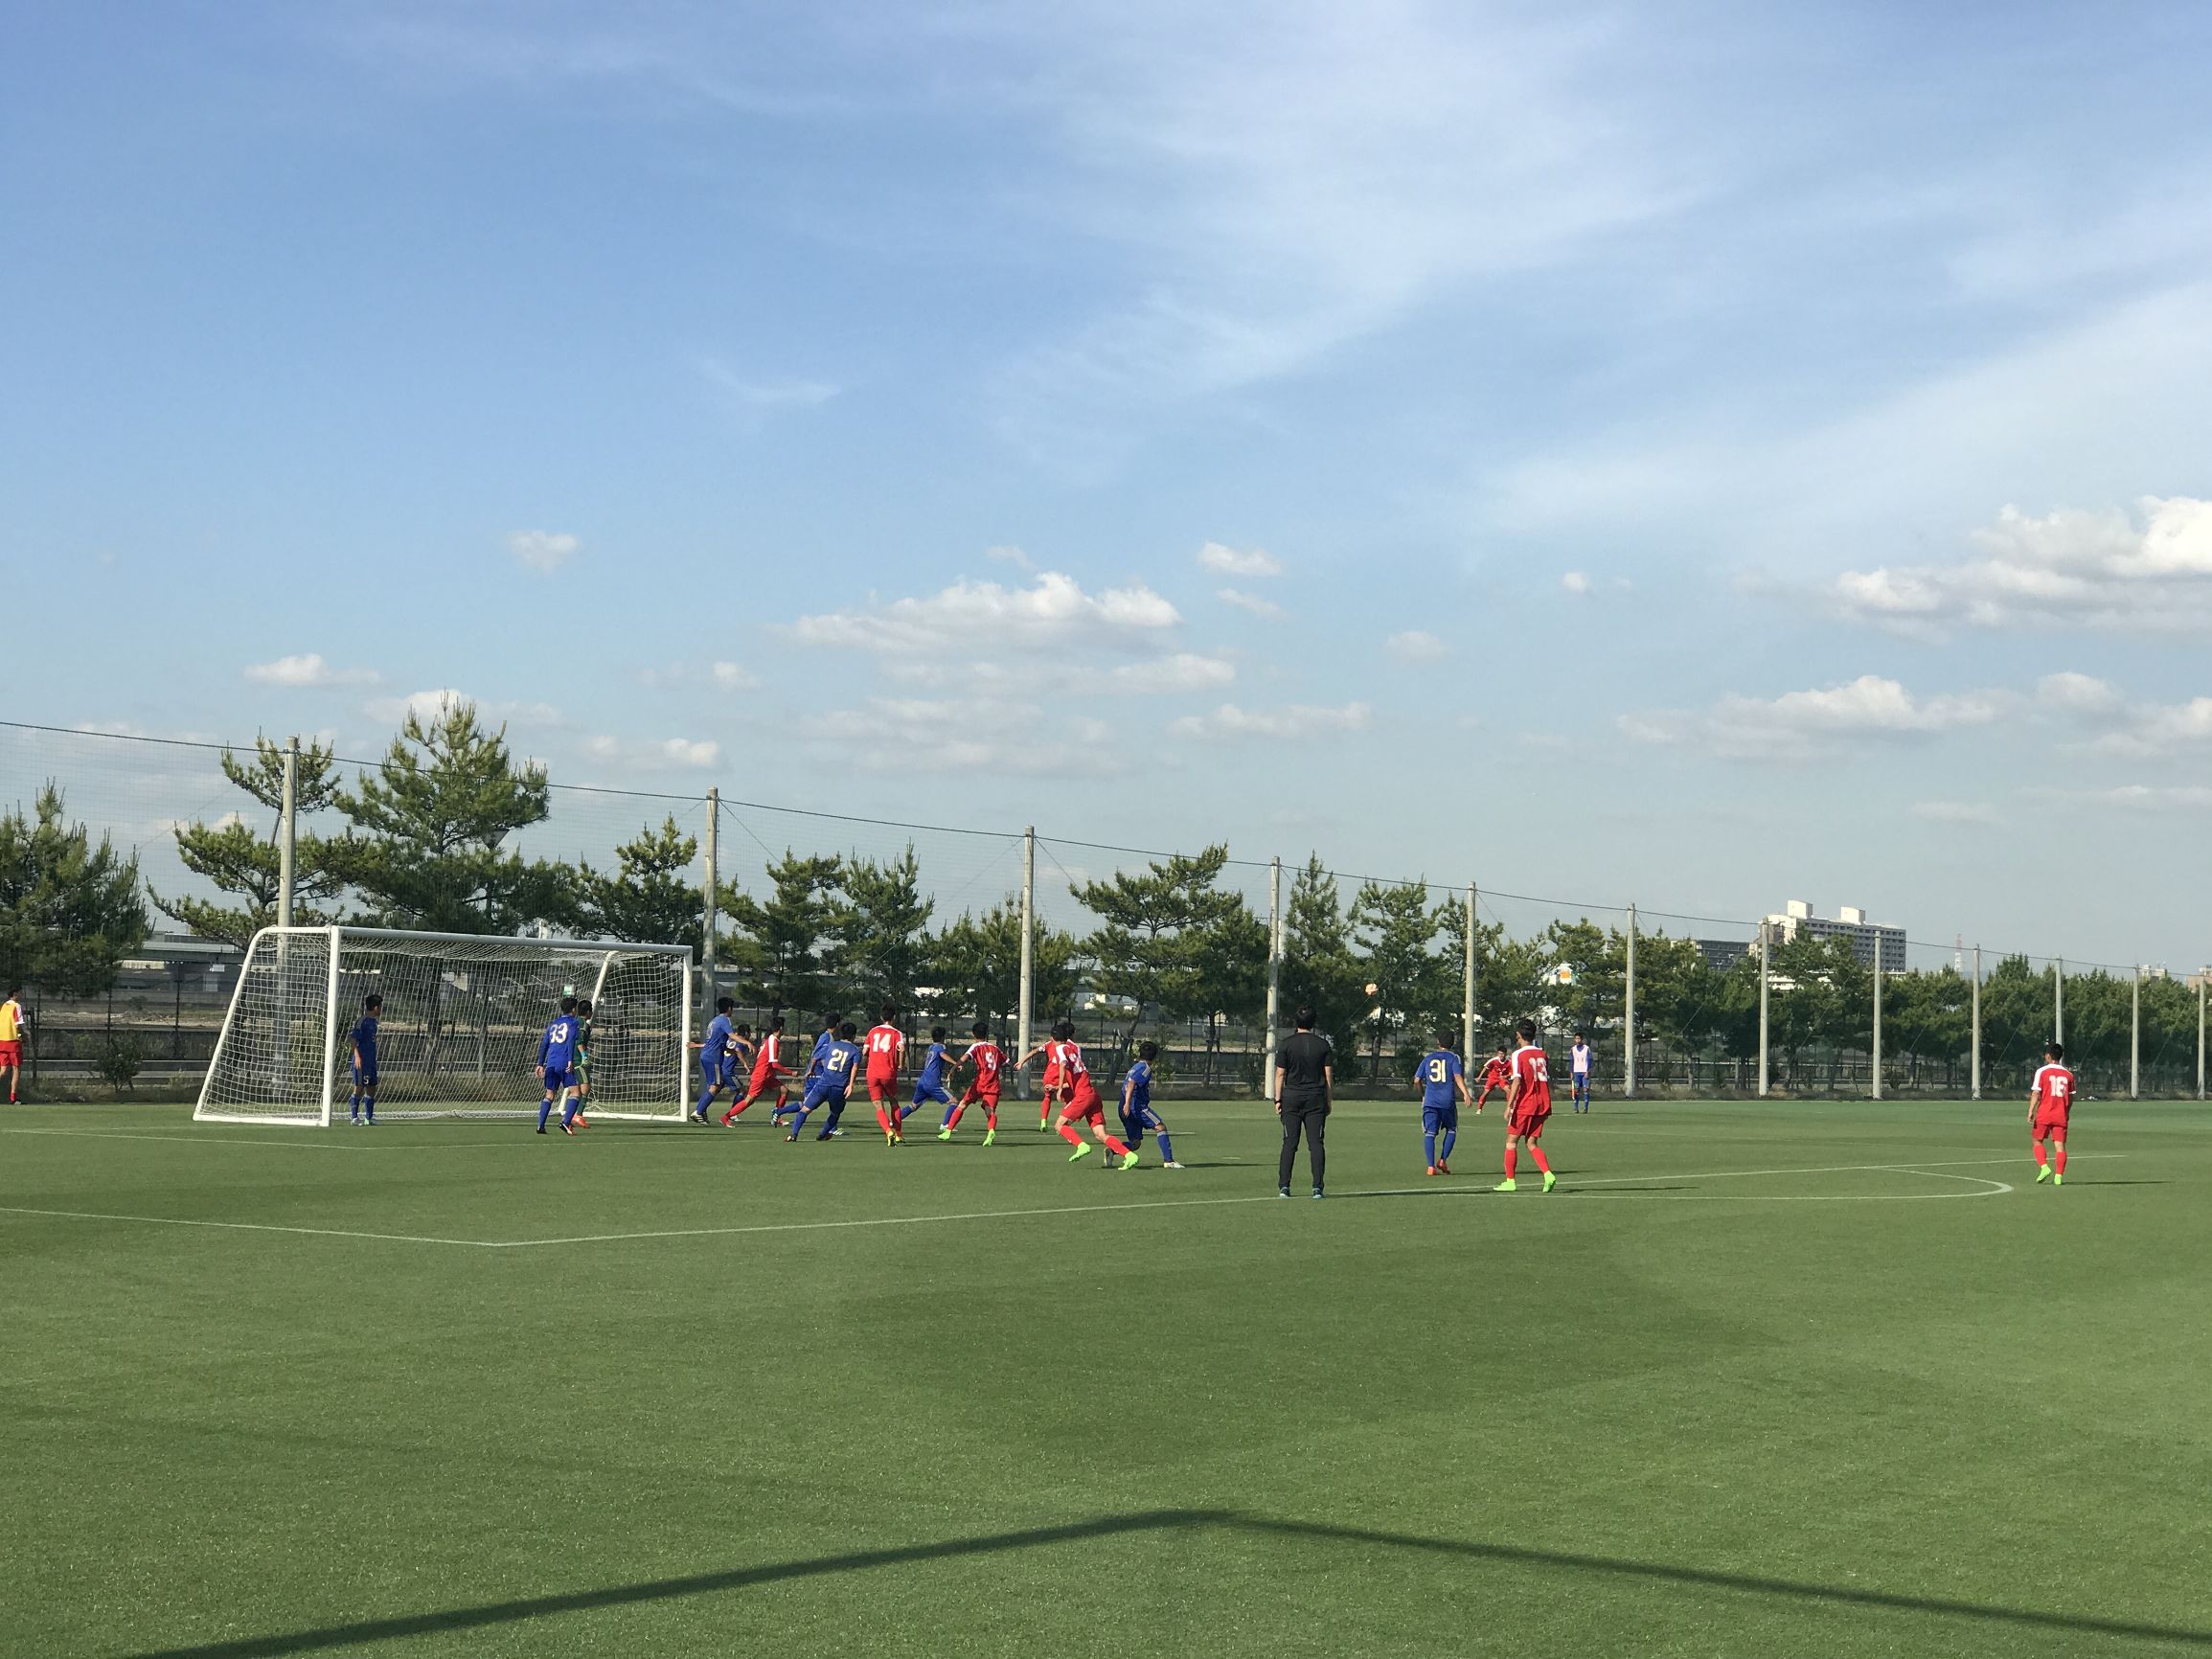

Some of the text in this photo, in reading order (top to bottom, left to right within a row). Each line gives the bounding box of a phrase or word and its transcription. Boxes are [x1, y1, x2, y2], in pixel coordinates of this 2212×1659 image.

[873, 1034, 891, 1053] 14
[828, 1049, 849, 1072] 21
[1428, 1058, 1447, 1083] 31
[1528, 1057, 1548, 1082] 13
[2048, 1075, 2068, 1097] 16
